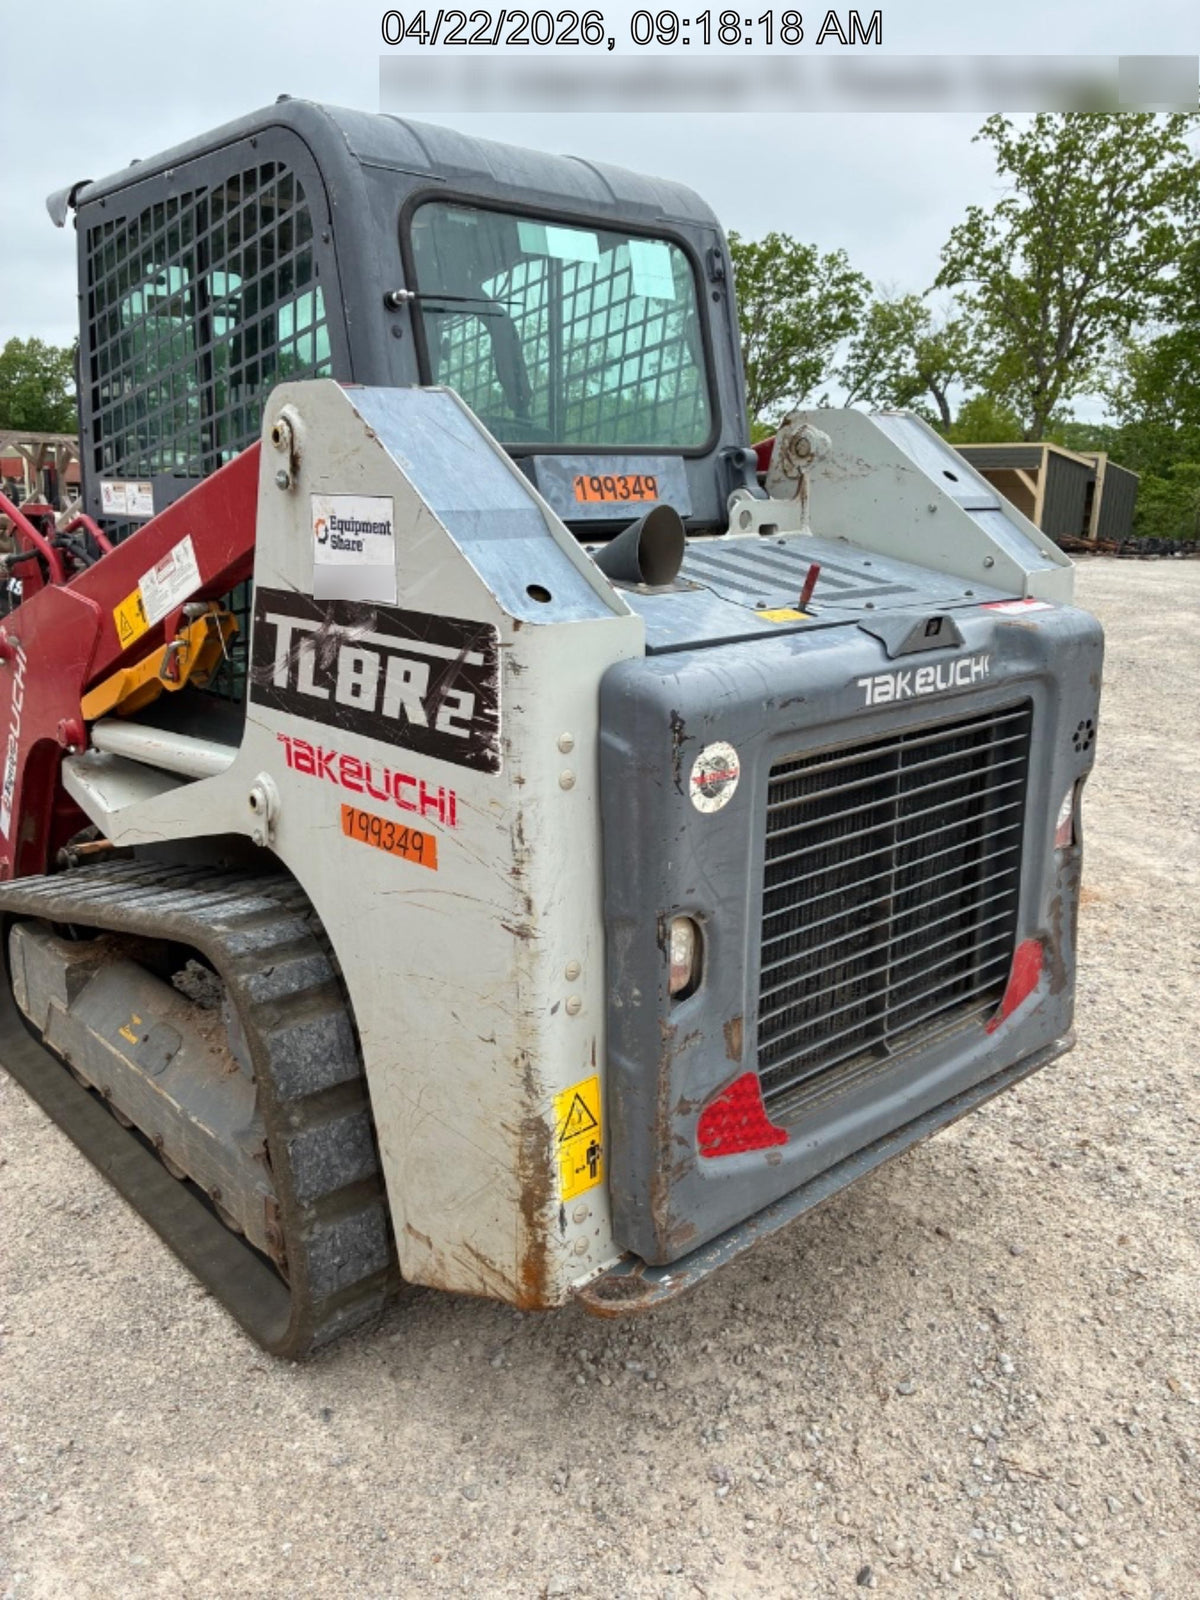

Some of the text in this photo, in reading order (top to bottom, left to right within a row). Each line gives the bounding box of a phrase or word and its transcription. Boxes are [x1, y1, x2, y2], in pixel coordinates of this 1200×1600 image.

[575, 475, 658, 503] 199349
[330, 515, 392, 536] Equipment
[330, 534, 364, 552] Share
[277, 732, 458, 828] TAKEUCHI
[346, 807, 425, 864] 199349
